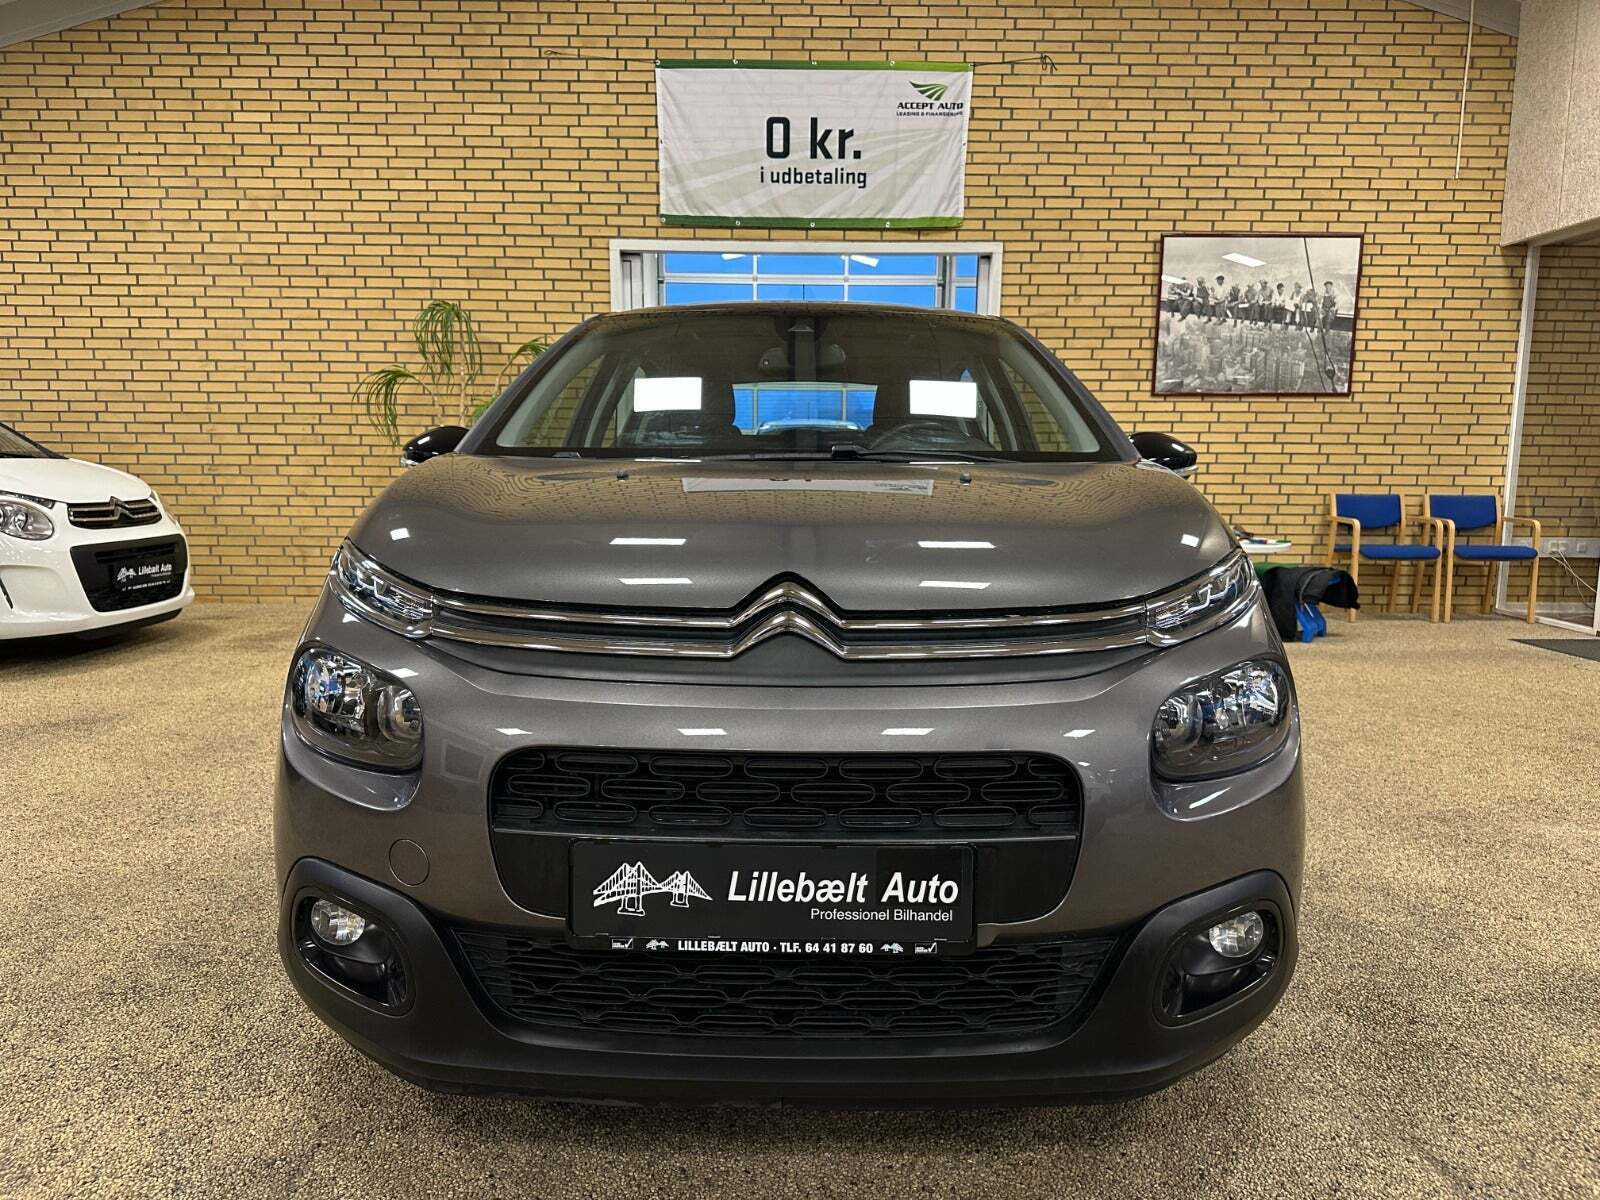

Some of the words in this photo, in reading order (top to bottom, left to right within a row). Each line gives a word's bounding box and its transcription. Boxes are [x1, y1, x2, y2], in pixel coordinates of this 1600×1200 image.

[897, 102, 935, 110] ACCEPT
[937, 102, 964, 110] AUTO
[766, 116, 791, 160] 0
[809, 116, 862, 160] kr.
[760, 166, 765, 184] i
[770, 167, 867, 189] udbetaling
[727, 870, 869, 903] Lillebælt
[880, 871, 959, 904] Auto
[810, 908, 890, 921] Professionel
[893, 908, 953, 922] Bilhandel
[677, 940, 738, 952] LILLEBÆLT
[740, 941, 770, 953] AUTO
[779, 942, 802, 953] TLF.
[804, 942, 820, 954] 64
[822, 942, 837, 954] 41
[840, 943, 856, 954] 87
[858, 943, 874, 954] 60
